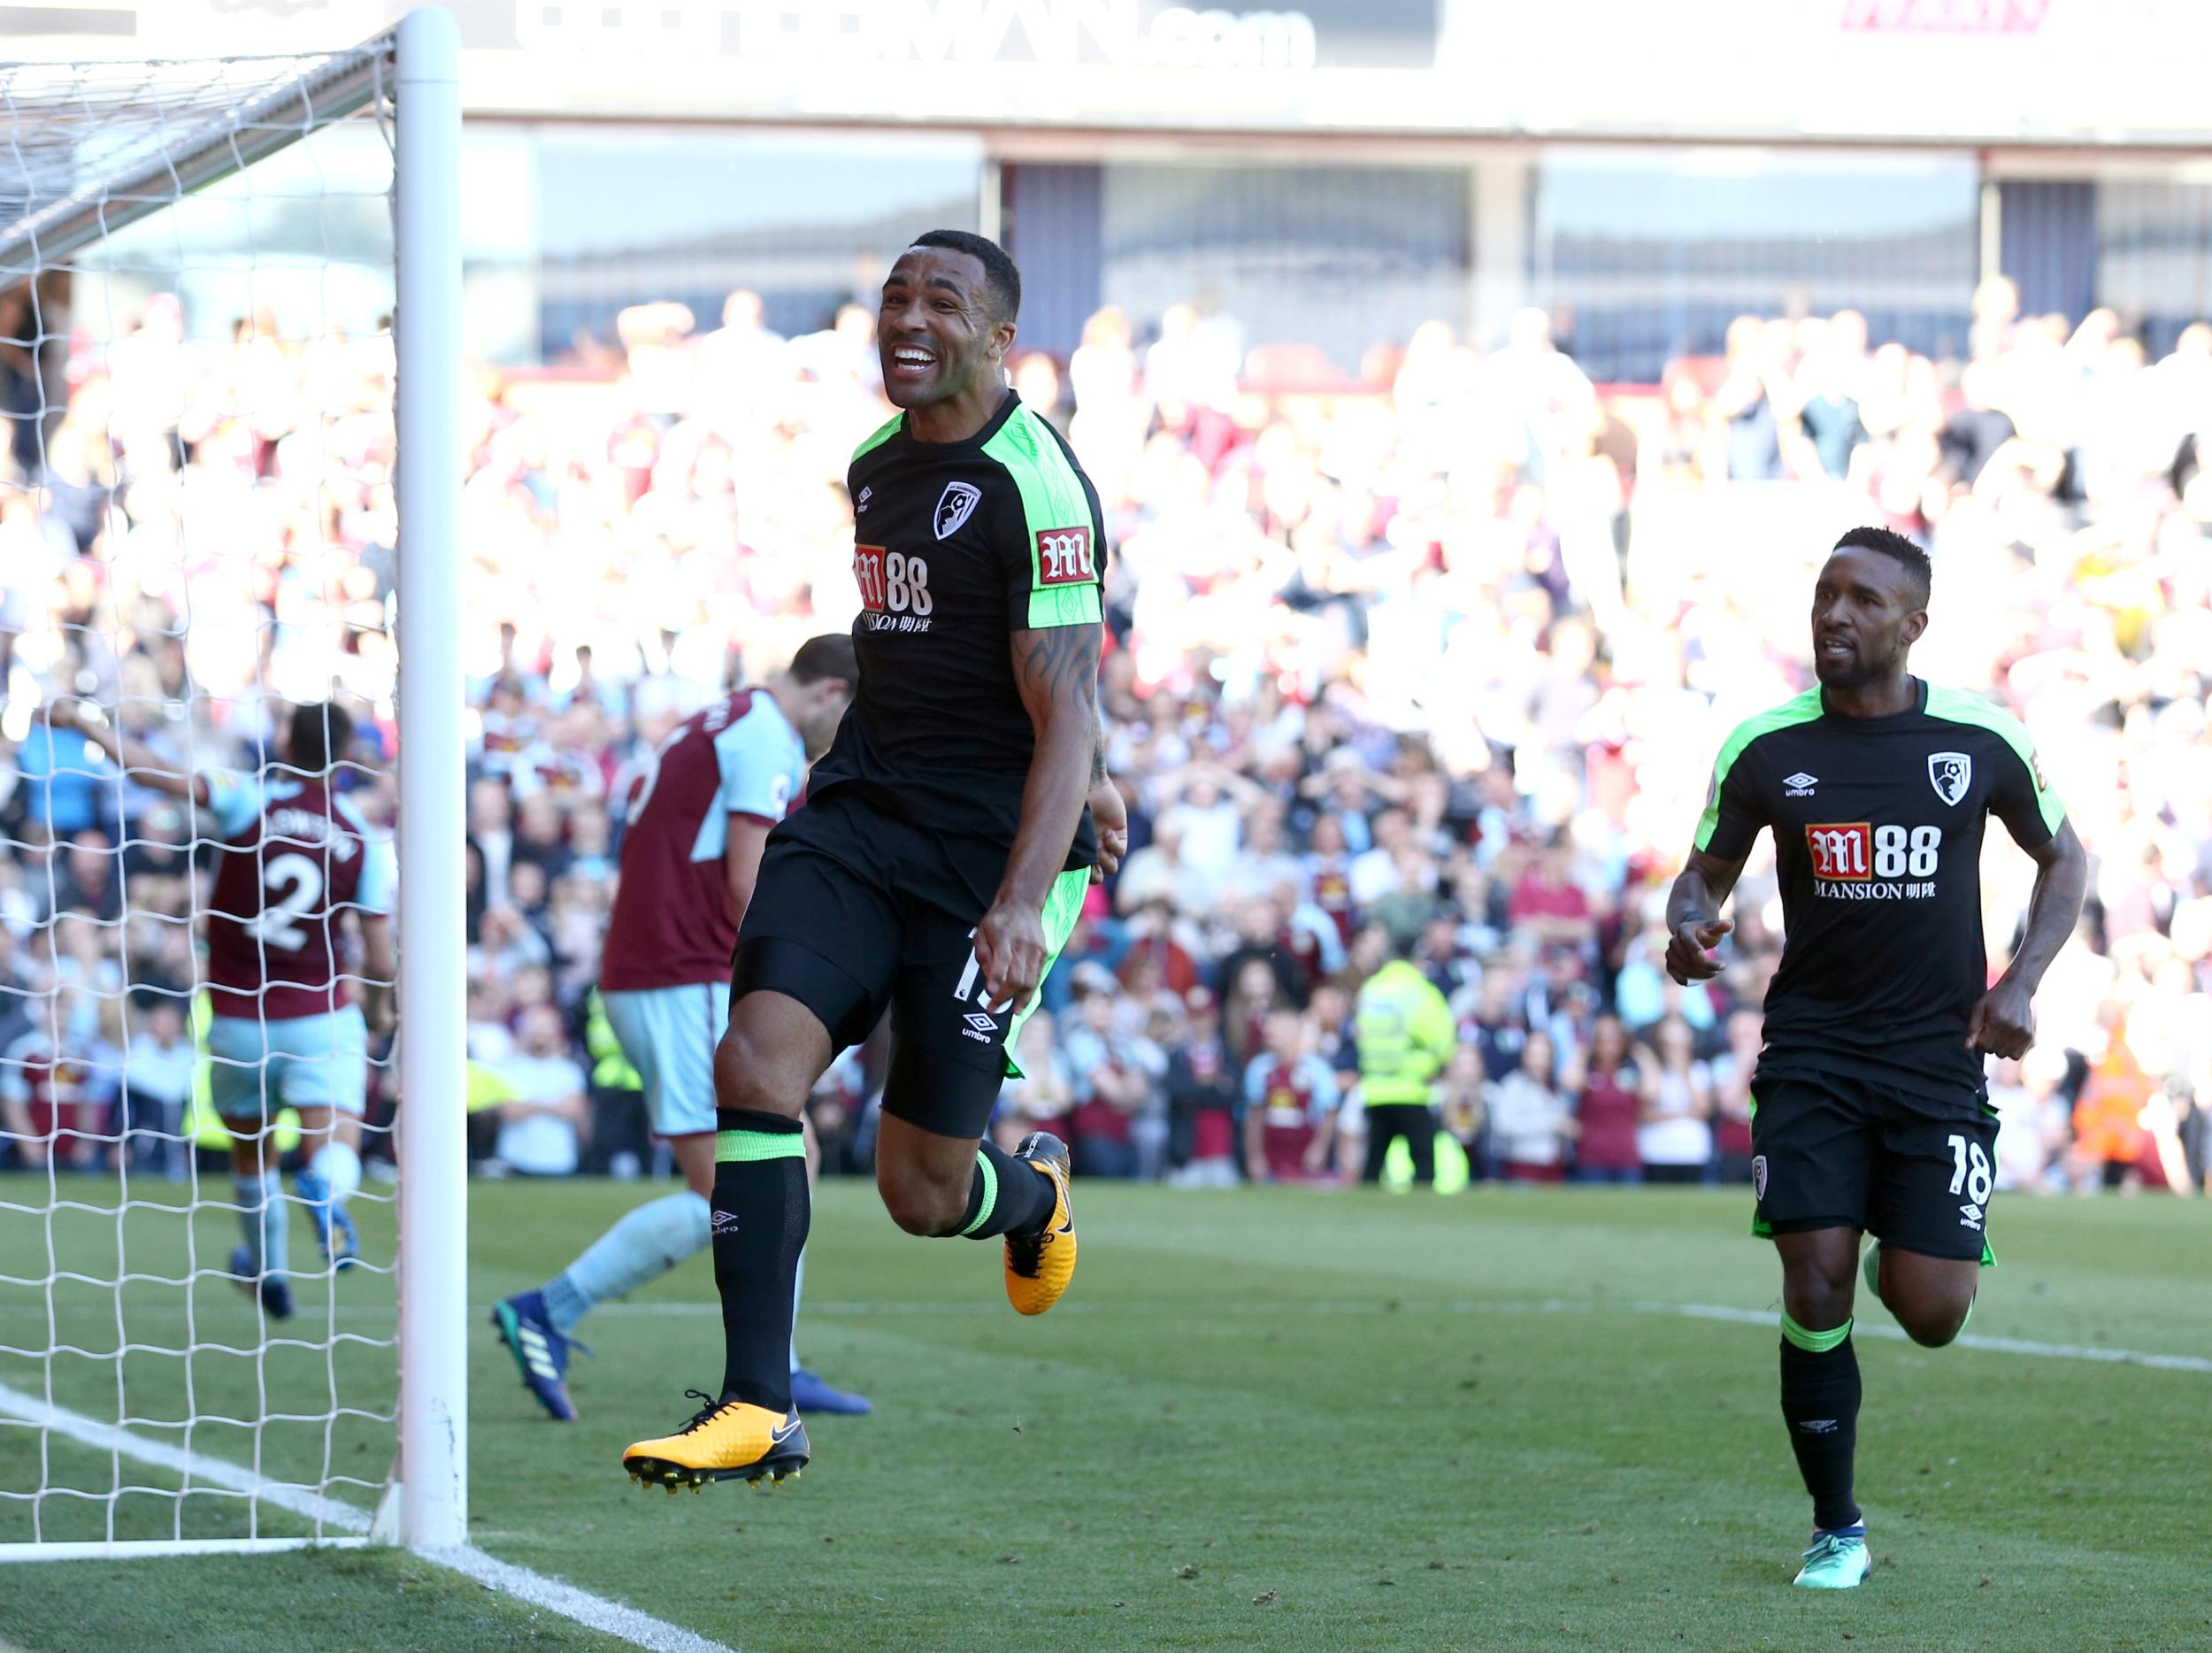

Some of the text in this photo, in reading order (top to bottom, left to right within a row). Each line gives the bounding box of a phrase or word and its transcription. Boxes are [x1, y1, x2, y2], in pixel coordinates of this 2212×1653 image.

[1041, 533, 1091, 578] M
[1785, 787, 1816, 797] umbro
[242, 852, 324, 951] 2
[1813, 879, 1903, 900] MANSION
[954, 926, 1014, 1014] 1
[962, 1026, 991, 1044] umbro
[1947, 1134, 1993, 1205] 18
